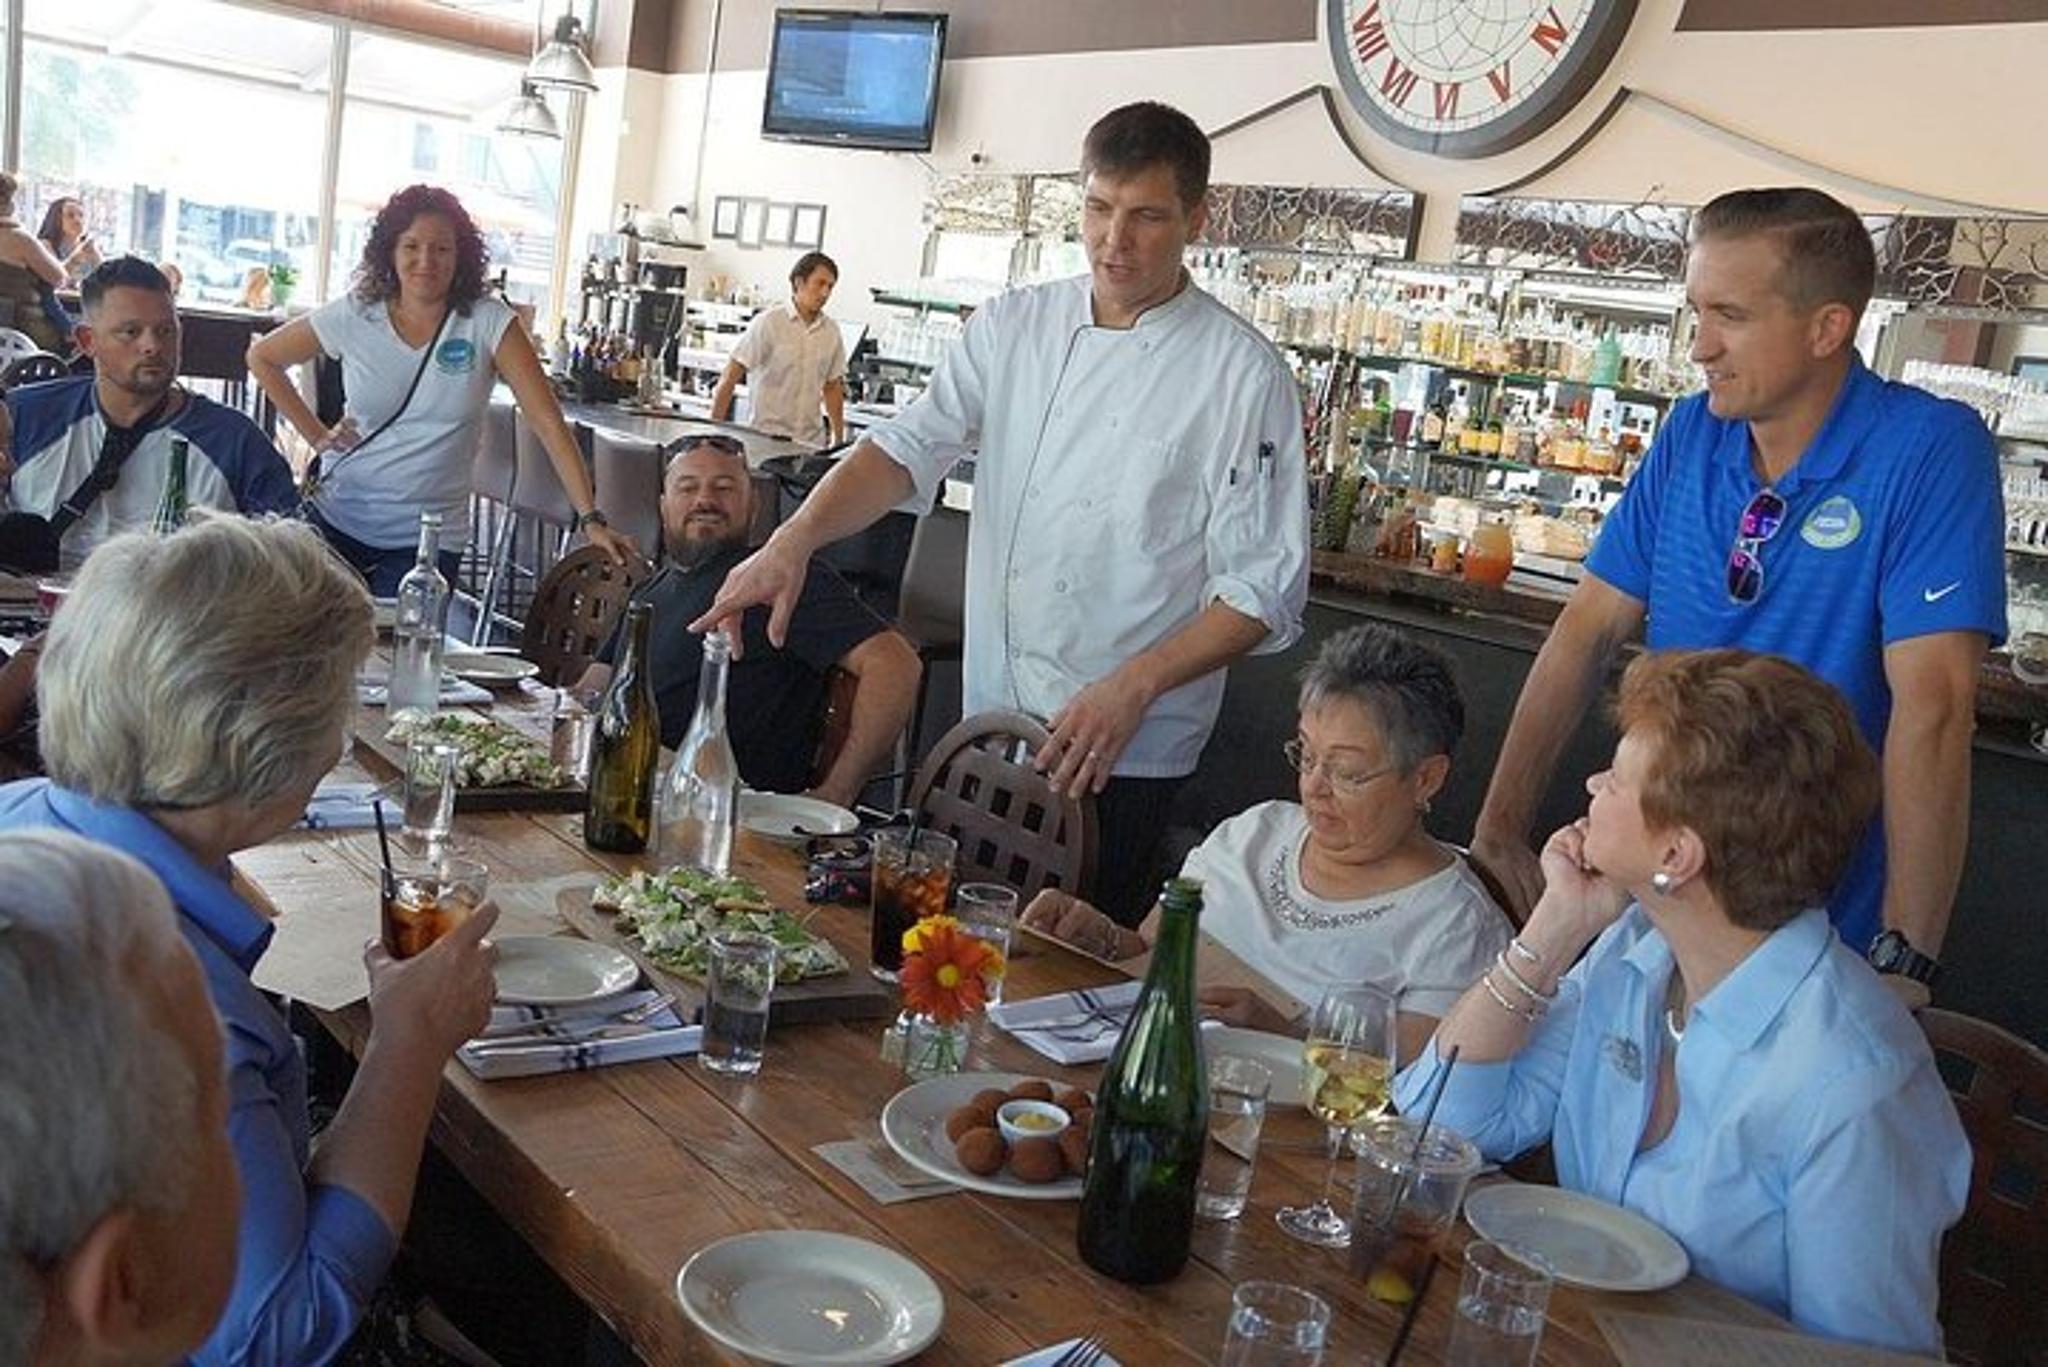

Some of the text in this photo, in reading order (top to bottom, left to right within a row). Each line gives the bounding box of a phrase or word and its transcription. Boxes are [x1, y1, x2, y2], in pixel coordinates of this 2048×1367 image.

[1353, 0, 1389, 62] VIII
[1380, 57, 1420, 108] VII
[1433, 82, 1461, 120] VI
[1486, 60, 1513, 104] V
